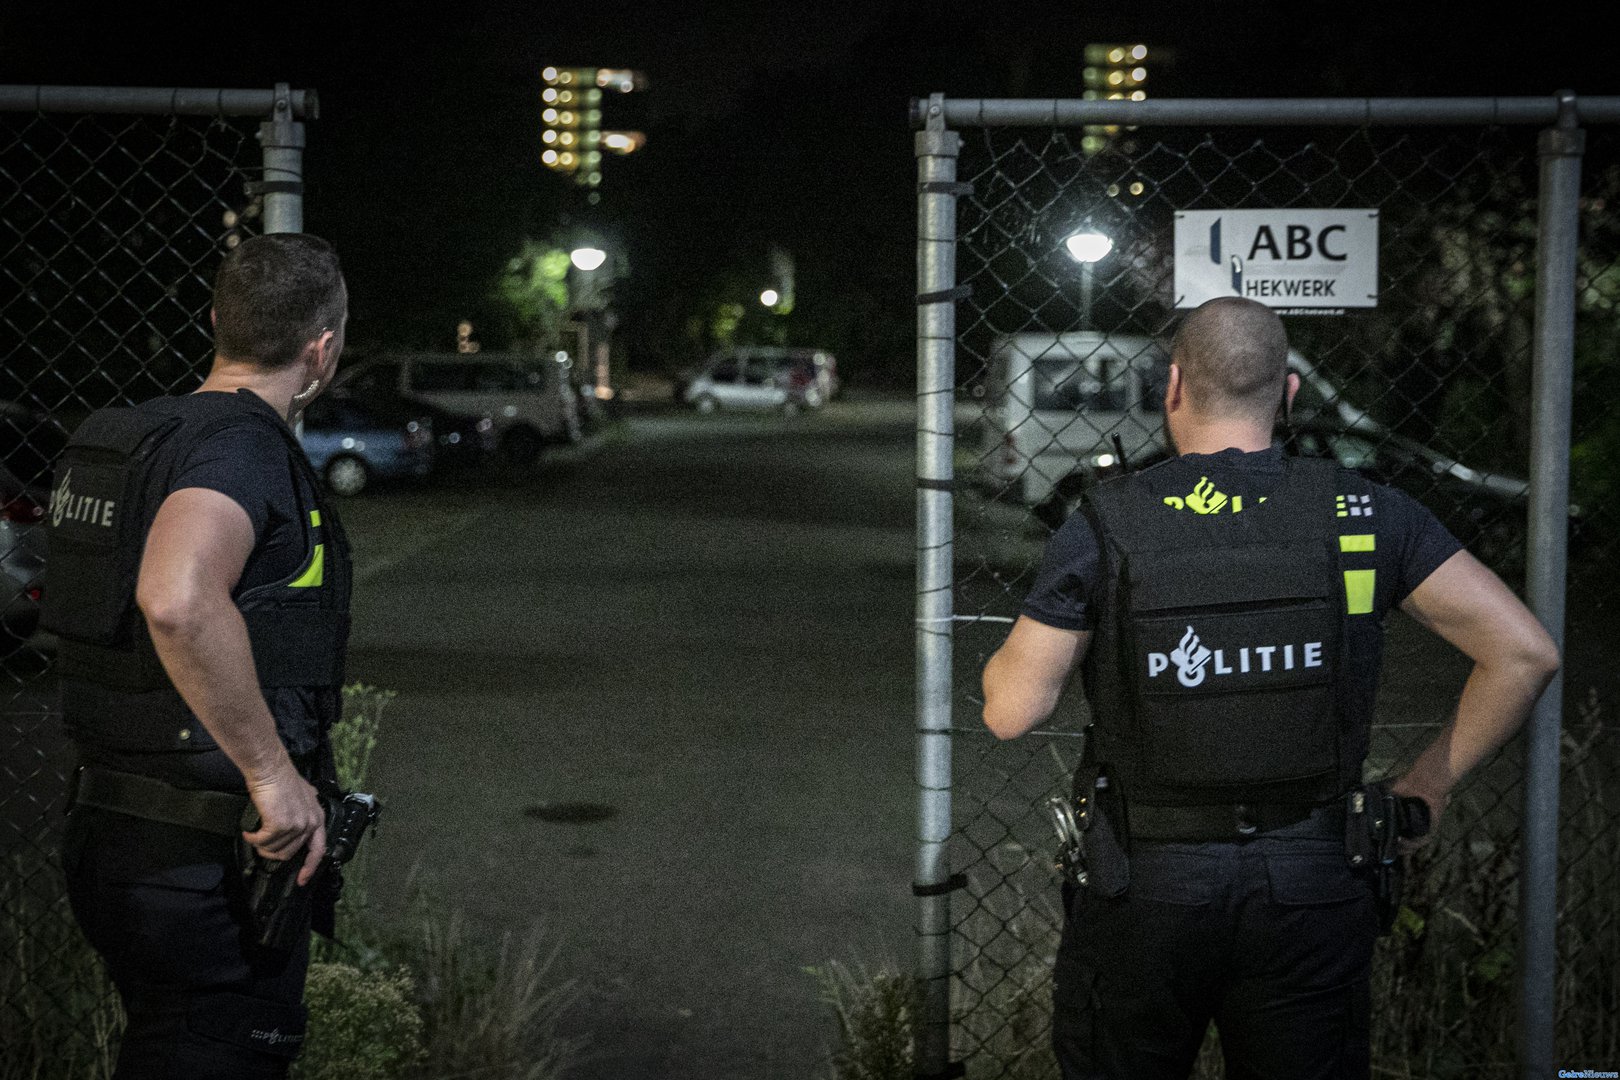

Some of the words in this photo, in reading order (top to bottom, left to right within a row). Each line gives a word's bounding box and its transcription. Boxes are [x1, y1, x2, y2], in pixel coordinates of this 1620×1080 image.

[1247, 224, 1348, 261] ABC
[1246, 279, 1336, 297] HEKWERK
[1148, 625, 1323, 688] POLITIE
